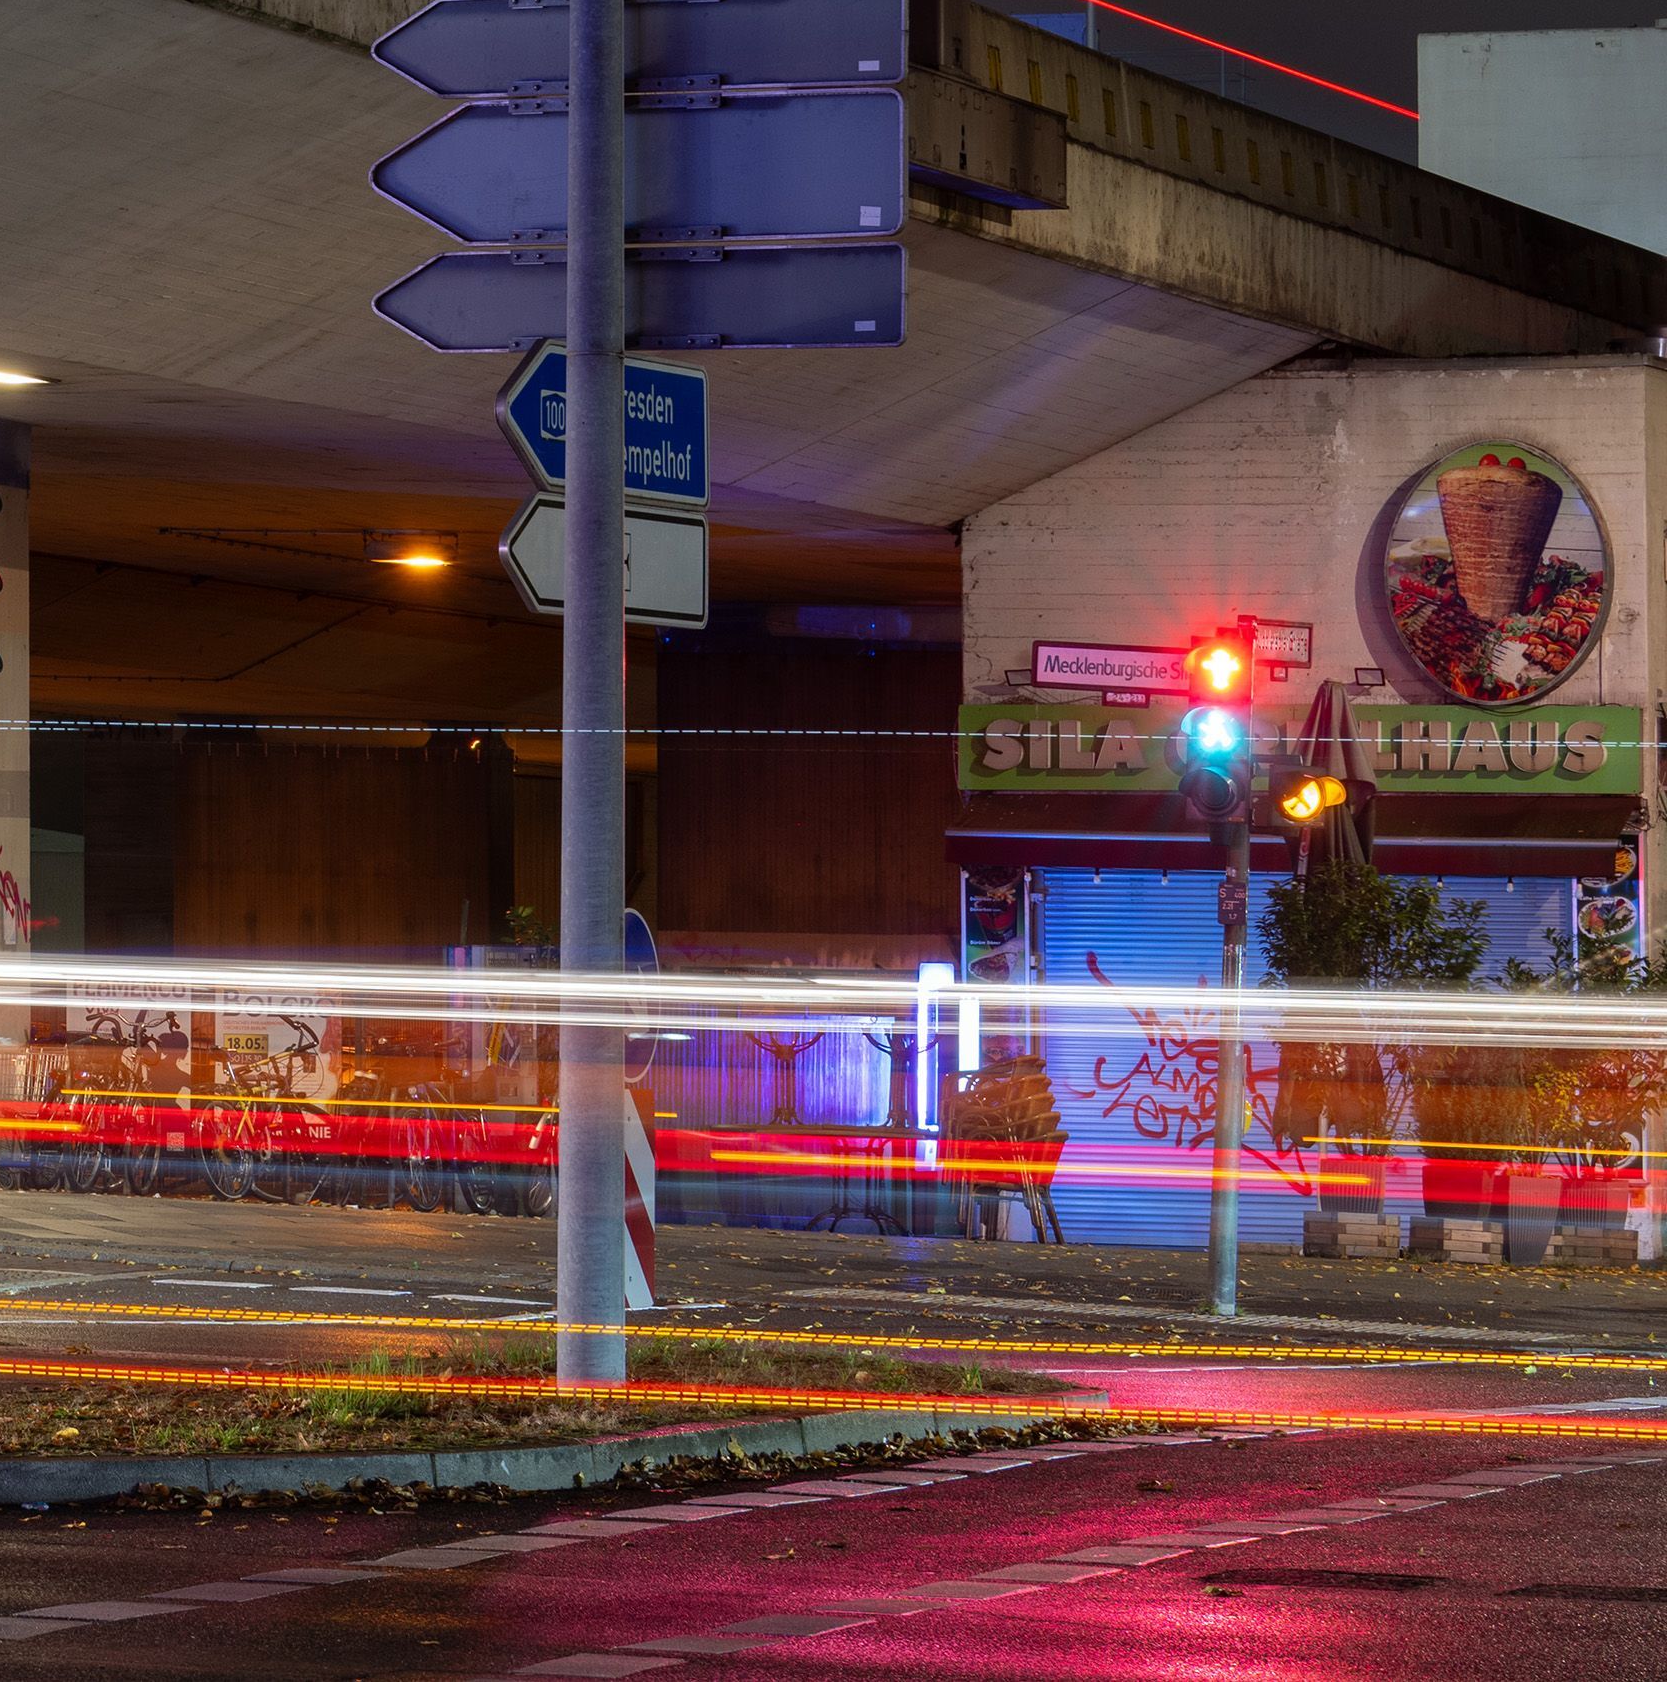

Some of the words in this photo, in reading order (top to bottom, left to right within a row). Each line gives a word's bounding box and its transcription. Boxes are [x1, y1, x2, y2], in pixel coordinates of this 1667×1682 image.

[545, 400, 565, 431] 100
[1043, 655, 1167, 681] Mecklenburgische
[982, 718, 1146, 772] SILA
[227, 1037, 265, 1050] 18.05.
